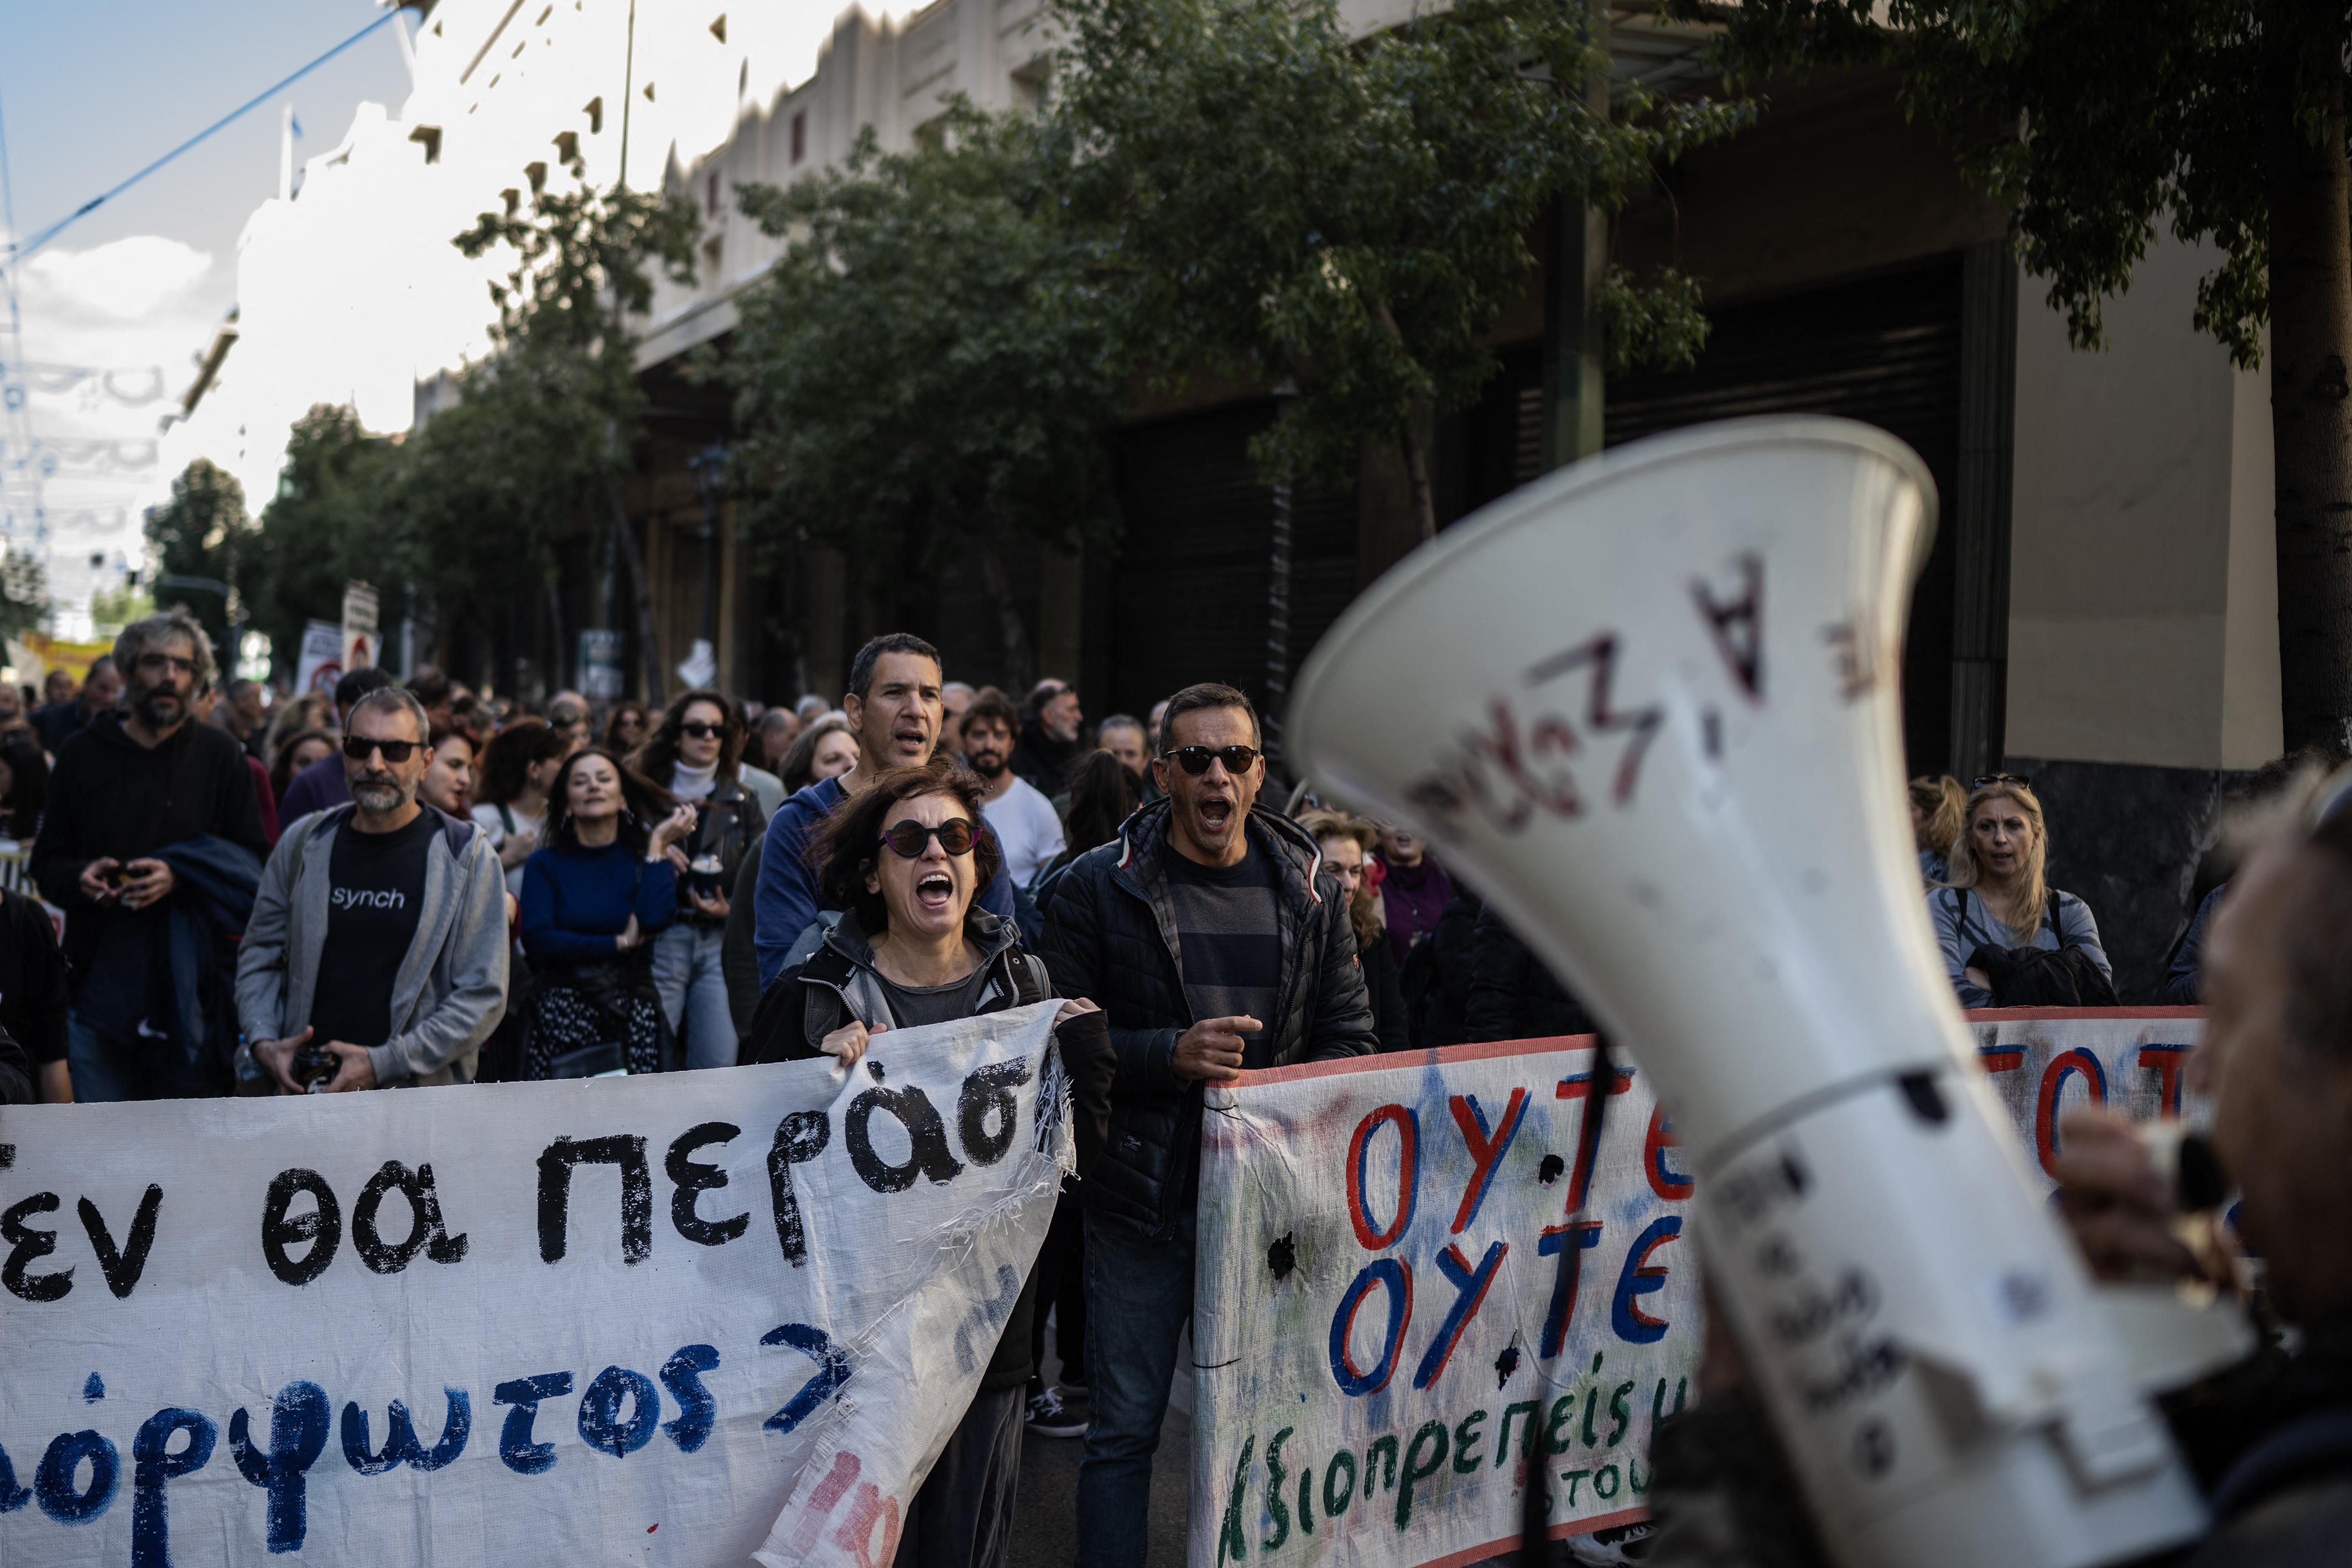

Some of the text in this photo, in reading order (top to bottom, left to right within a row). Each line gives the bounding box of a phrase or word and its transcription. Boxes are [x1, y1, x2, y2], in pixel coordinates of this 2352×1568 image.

[332, 886, 405, 910] synch
[0, 1051, 1051, 1301] εν θα περάσ
[1329, 1215, 1683, 1397] ΟΥΤΕ
[0, 1343, 720, 1568] όρφωτος
